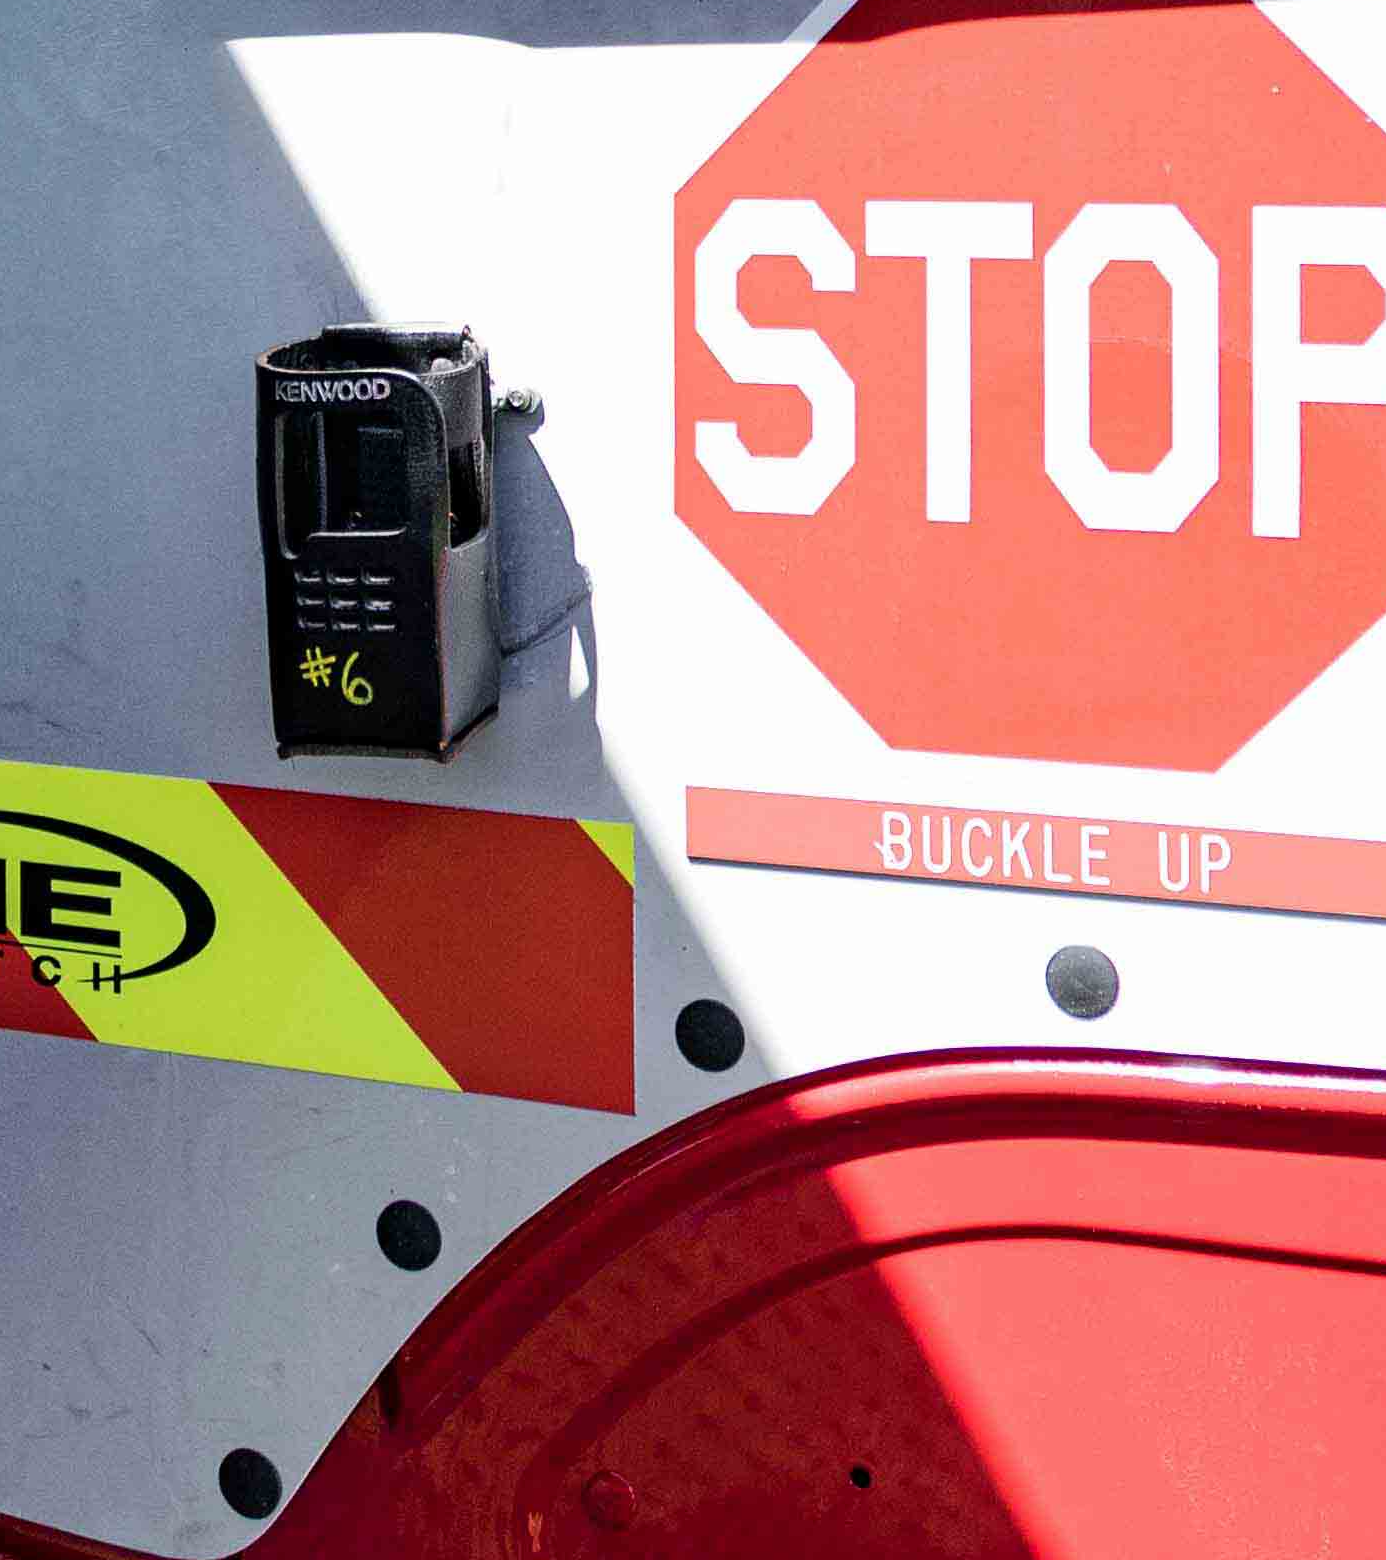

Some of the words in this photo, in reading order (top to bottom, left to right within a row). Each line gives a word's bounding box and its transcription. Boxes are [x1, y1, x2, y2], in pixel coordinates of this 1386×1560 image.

[276, 378, 390, 402] KENWOOD
[299, 647, 375, 706] #6
[881, 811, 1111, 886] BUCKLE
[1157, 831, 1232, 894] UP
